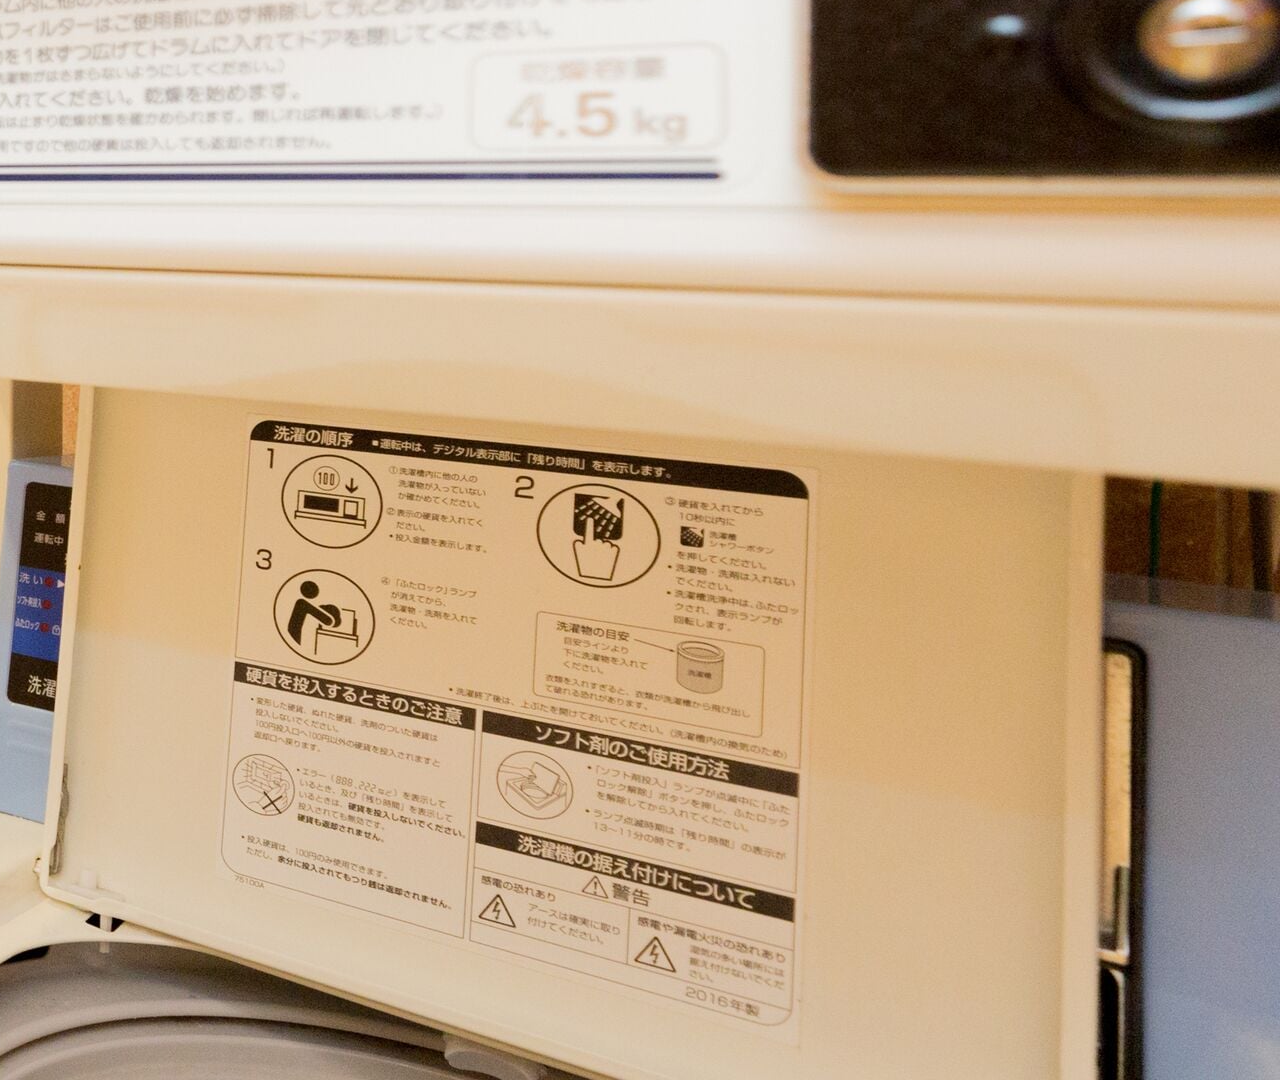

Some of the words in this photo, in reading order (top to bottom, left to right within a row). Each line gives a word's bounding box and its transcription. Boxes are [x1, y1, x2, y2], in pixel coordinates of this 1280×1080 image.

[506, 91, 618, 138] 4.5
[632, 110, 688, 140] kg
[266, 448, 275, 469] 1
[273, 424, 354, 448] 洗濯の順序
[379, 437, 673, 479] 運転中は、デジタル表示部に「残り時間」を表示します。
[317, 471, 336, 487] 100
[397, 479, 487, 497] 洗濯物が入っていない
[514, 475, 535, 499] 2
[34, 532, 64, 546] 運転中
[255, 549, 273, 570] 3
[18, 571, 44, 585] 洗い
[556, 620, 630, 642] 洗濯物の目安
[563, 636, 629, 654] 目安ラインより
[563, 648, 649, 670] 下に洗濯物を入れて
[245, 666, 464, 726] 硬貨を投入するときのご注意
[255, 709, 340, 733] 投入しないでください。
[535, 724, 730, 781] ソフト剤のご使用方法
[517, 834, 756, 911] 洗濯機の据え付けについて
[481, 874, 557, 903] 感電の恐れあり
[611, 882, 651, 908] 警告
[638, 916, 787, 964] 感電や漏電火災の恐れあり
[684, 985, 761, 1019] 2016年製
